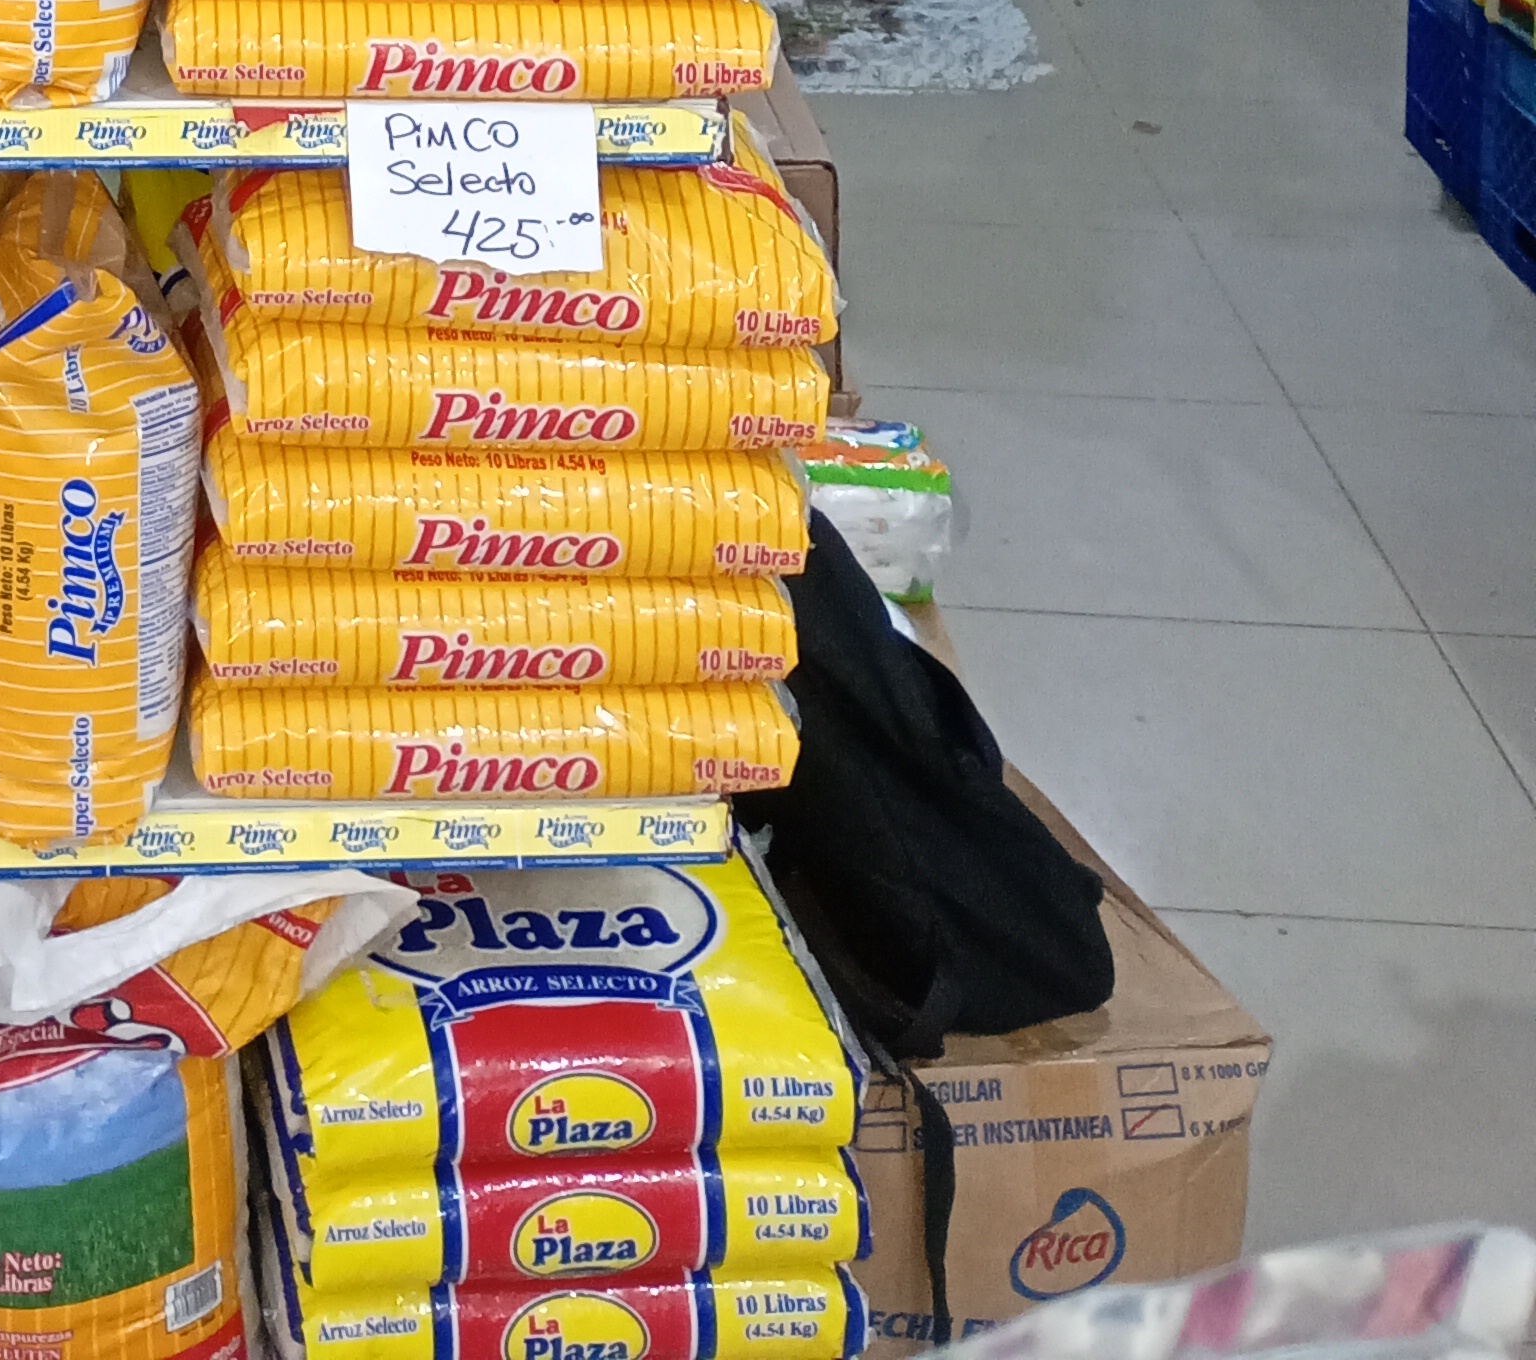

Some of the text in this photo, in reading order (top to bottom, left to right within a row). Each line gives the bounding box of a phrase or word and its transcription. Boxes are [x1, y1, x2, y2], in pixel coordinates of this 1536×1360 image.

[358, 42, 577, 94] Pimco
[596, 118, 667, 139] Pimco
[387, 160, 535, 195] Selecto
[424, 269, 640, 331] Pimco
[420, 391, 636, 441] Pimco
[403, 518, 621, 569] Pimco
[45, 478, 99, 666] Pimco
[103, 521, 124, 624] PREMIUM
[384, 742, 600, 795] Pimco
[398, 897, 679, 953] Plaza
[457, 975, 658, 998] ARROZ SELECTO
[743, 1078, 833, 1098] 10 Libras
[320, 1102, 423, 1124] Arroz Selecto
[534, 1095, 565, 1114] La
[750, 1105, 825, 1124] (4.54 Kg)
[528, 1119, 633, 1146] Plaza
[984, 1115, 1113, 1144] INSTANTANEA
[536, 1216, 568, 1234] La
[4, 1251, 61, 1271] Neto:
[532, 1239, 637, 1265] Plaza
[1026, 1233, 1110, 1270] Rica
